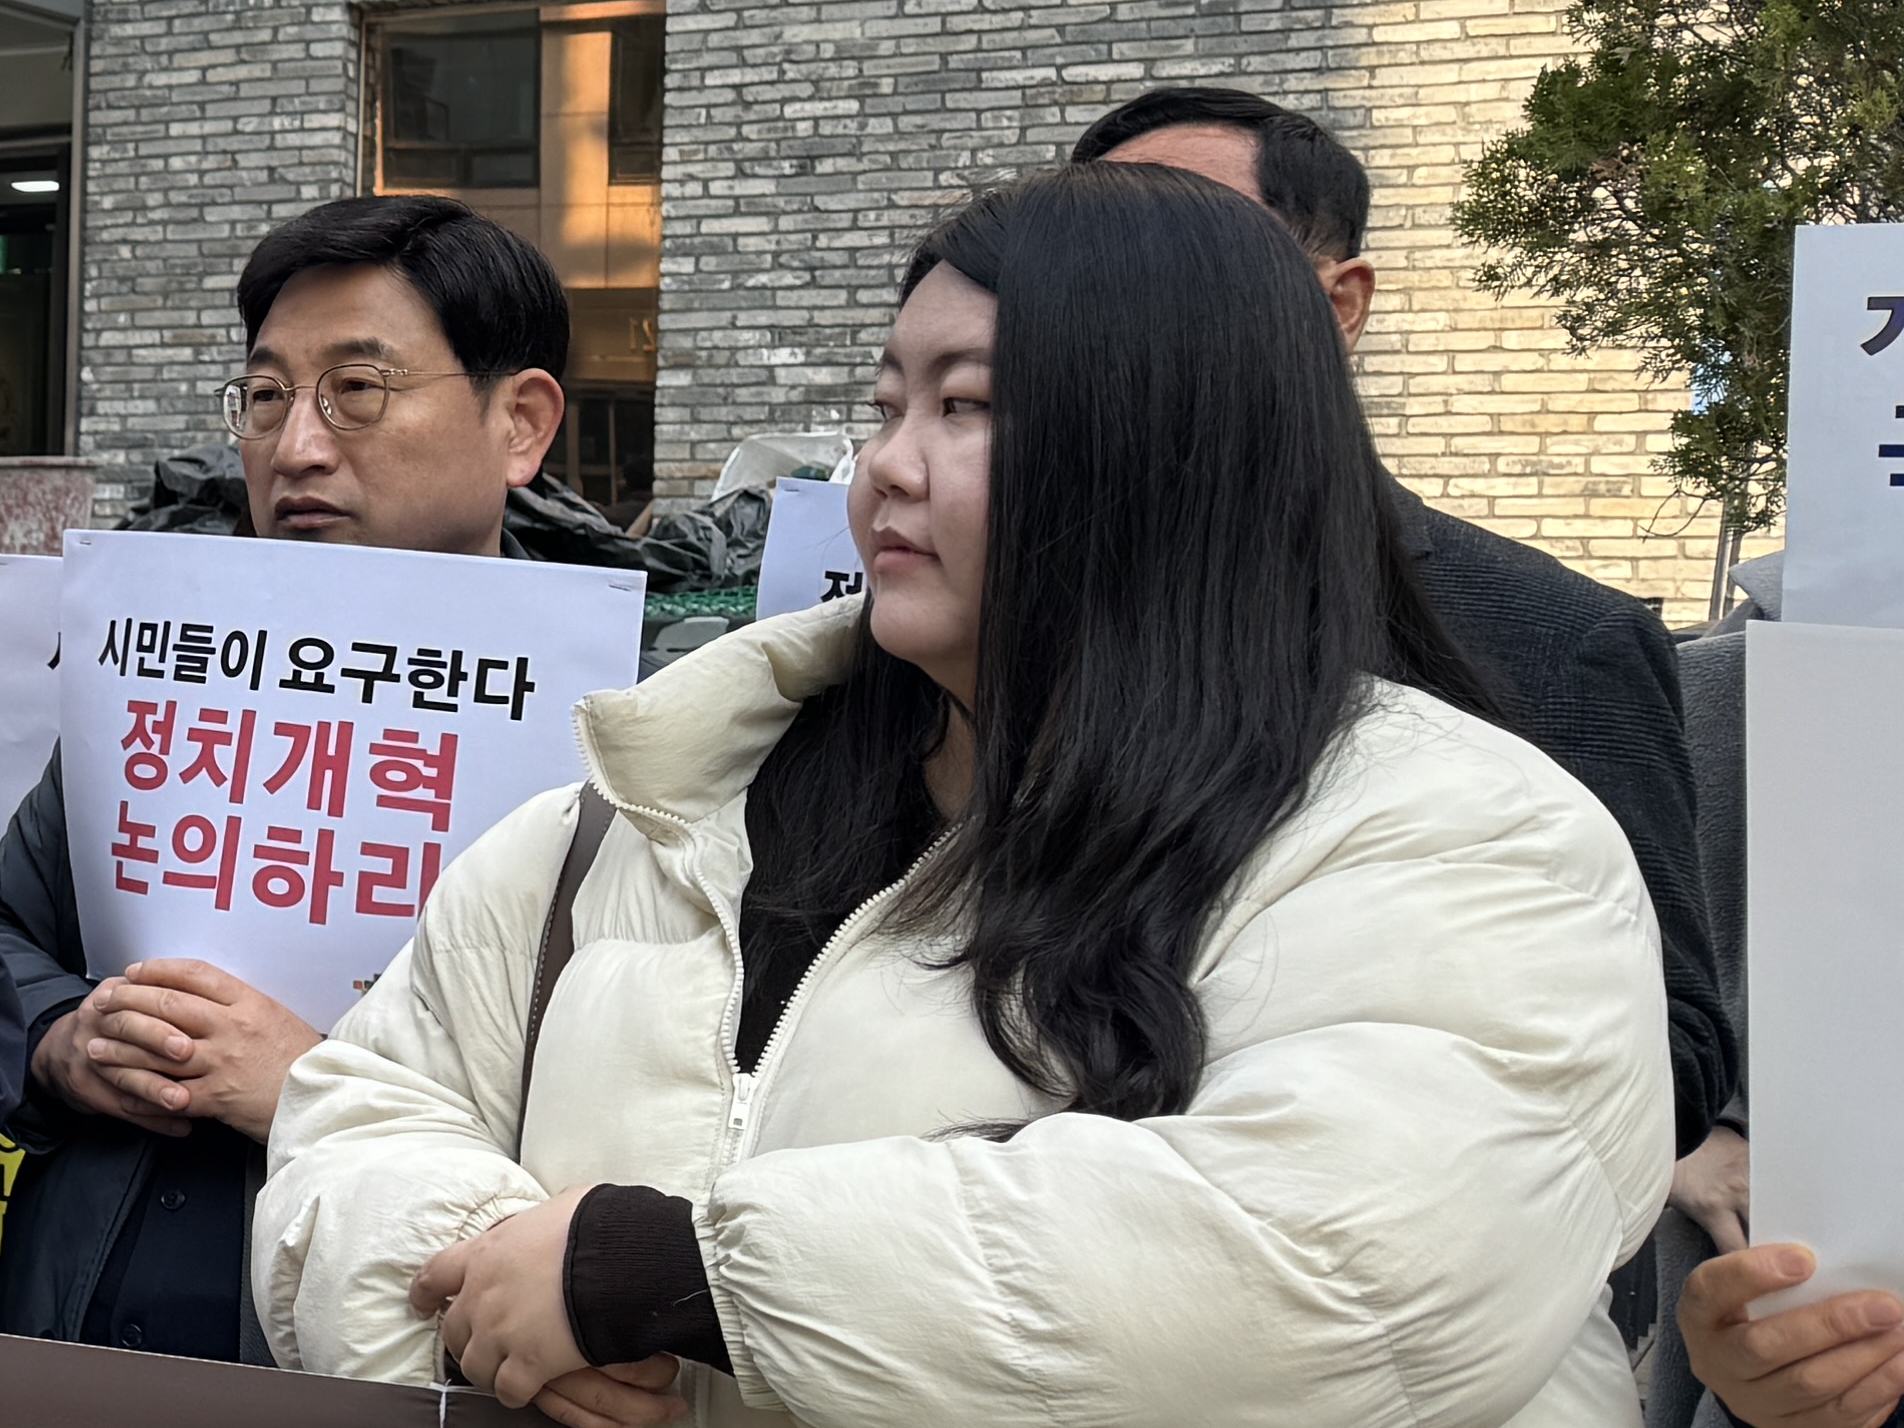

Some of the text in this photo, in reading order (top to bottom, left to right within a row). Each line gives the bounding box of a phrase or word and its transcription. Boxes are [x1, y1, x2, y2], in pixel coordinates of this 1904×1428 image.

[97, 615, 538, 723] 시민들이 요구한다
[118, 698, 462, 834] 정치개혁
